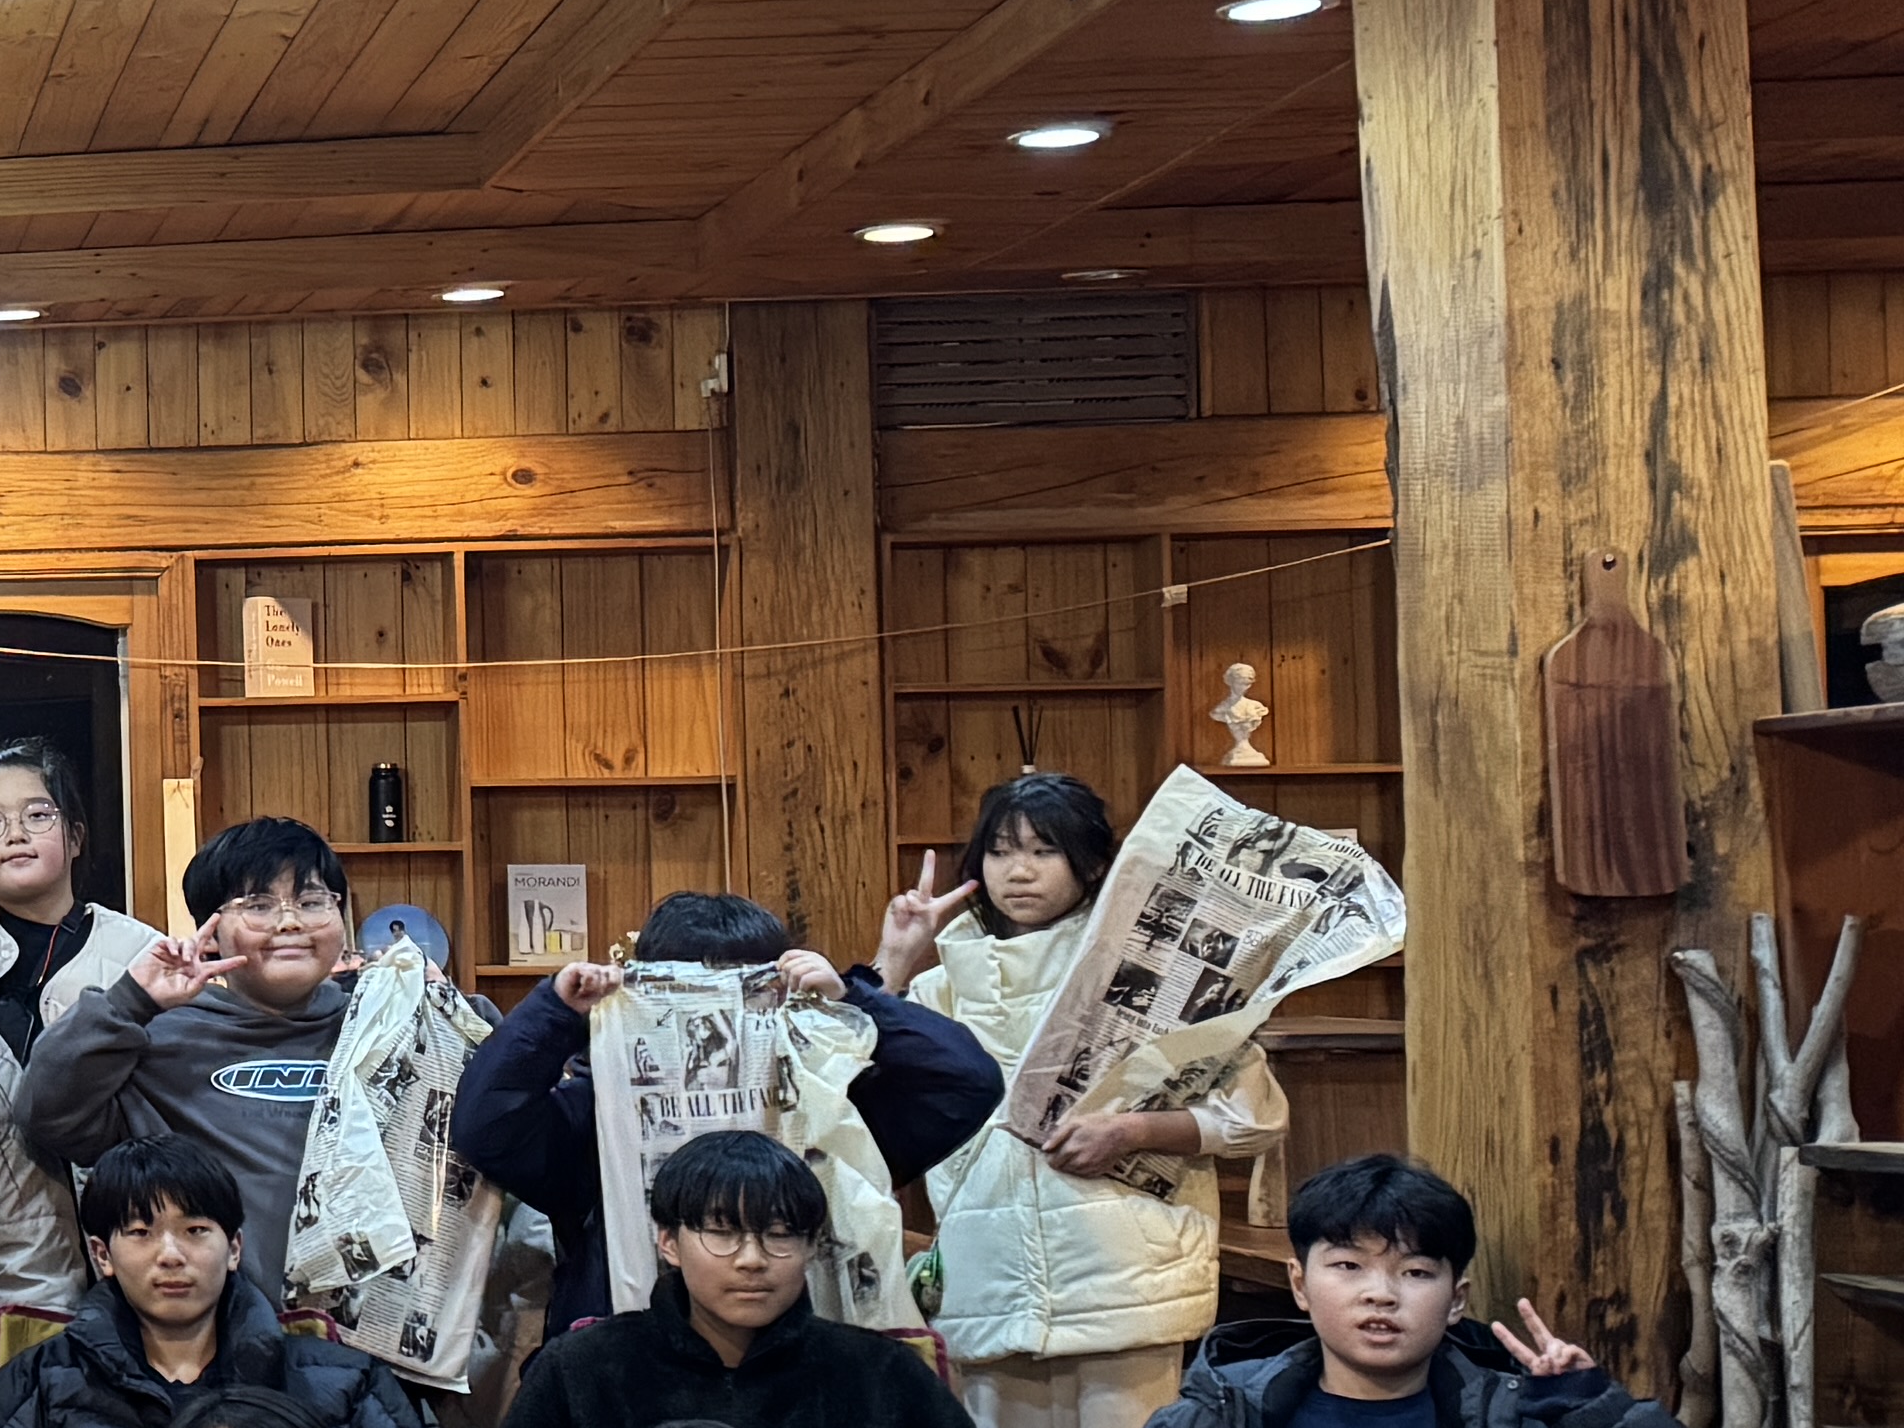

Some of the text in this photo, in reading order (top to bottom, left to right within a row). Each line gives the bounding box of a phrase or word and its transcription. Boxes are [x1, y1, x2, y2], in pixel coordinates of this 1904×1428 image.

[265, 619, 300, 636] Lonely
[265, 635, 292, 648] Ones
[267, 673, 303, 687] Powell
[514, 876, 580, 888] MORANDI
[1246, 875, 1277, 903] THE
